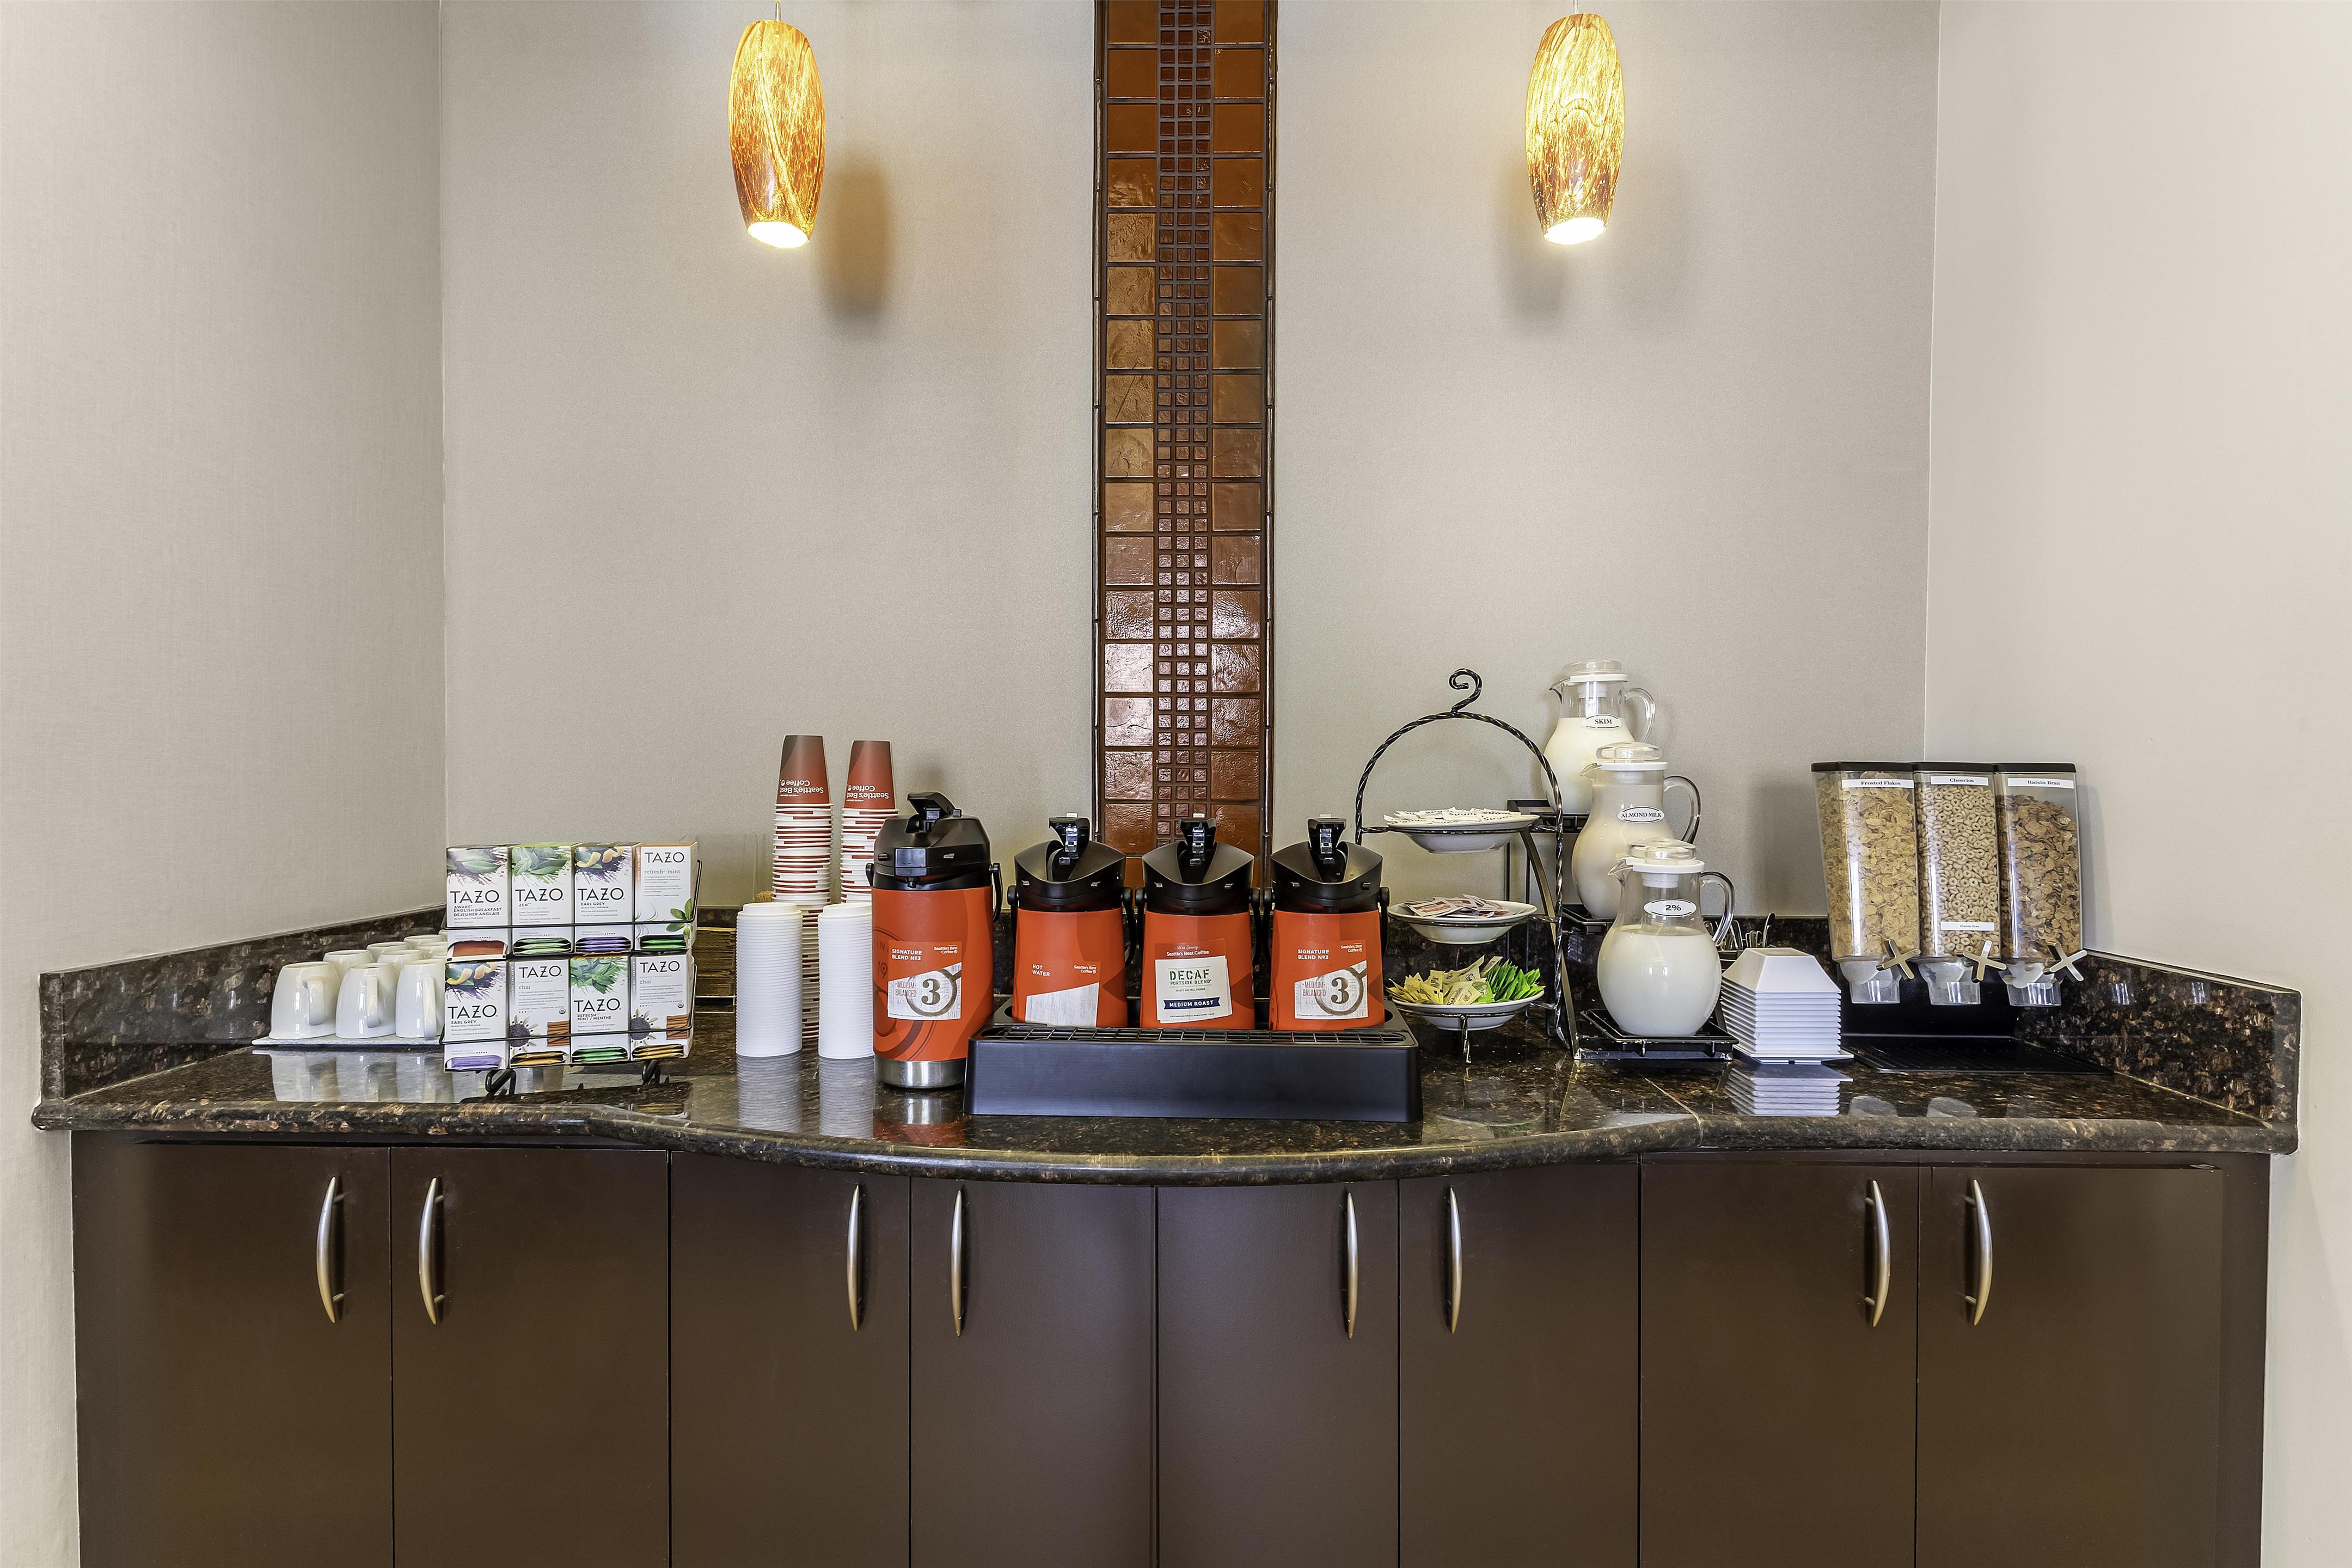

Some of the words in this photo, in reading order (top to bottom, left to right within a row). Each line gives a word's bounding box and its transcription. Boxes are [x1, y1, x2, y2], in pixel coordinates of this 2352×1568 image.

[644, 852, 684, 863] TAZO
[450, 890, 499, 903] TAZO
[514, 888, 563, 902] TAZO
[577, 887, 624, 901] TAZO
[518, 965, 561, 978] TAZO
[639, 960, 680, 973] TAZO
[1169, 969, 1210, 981] DECAF
[895, 988, 917, 997] BALANCED
[921, 978, 941, 1005] 3
[1331, 977, 1349, 1004] 3
[447, 1004, 497, 1019] TAZO
[573, 998, 620, 1012] TAZO
